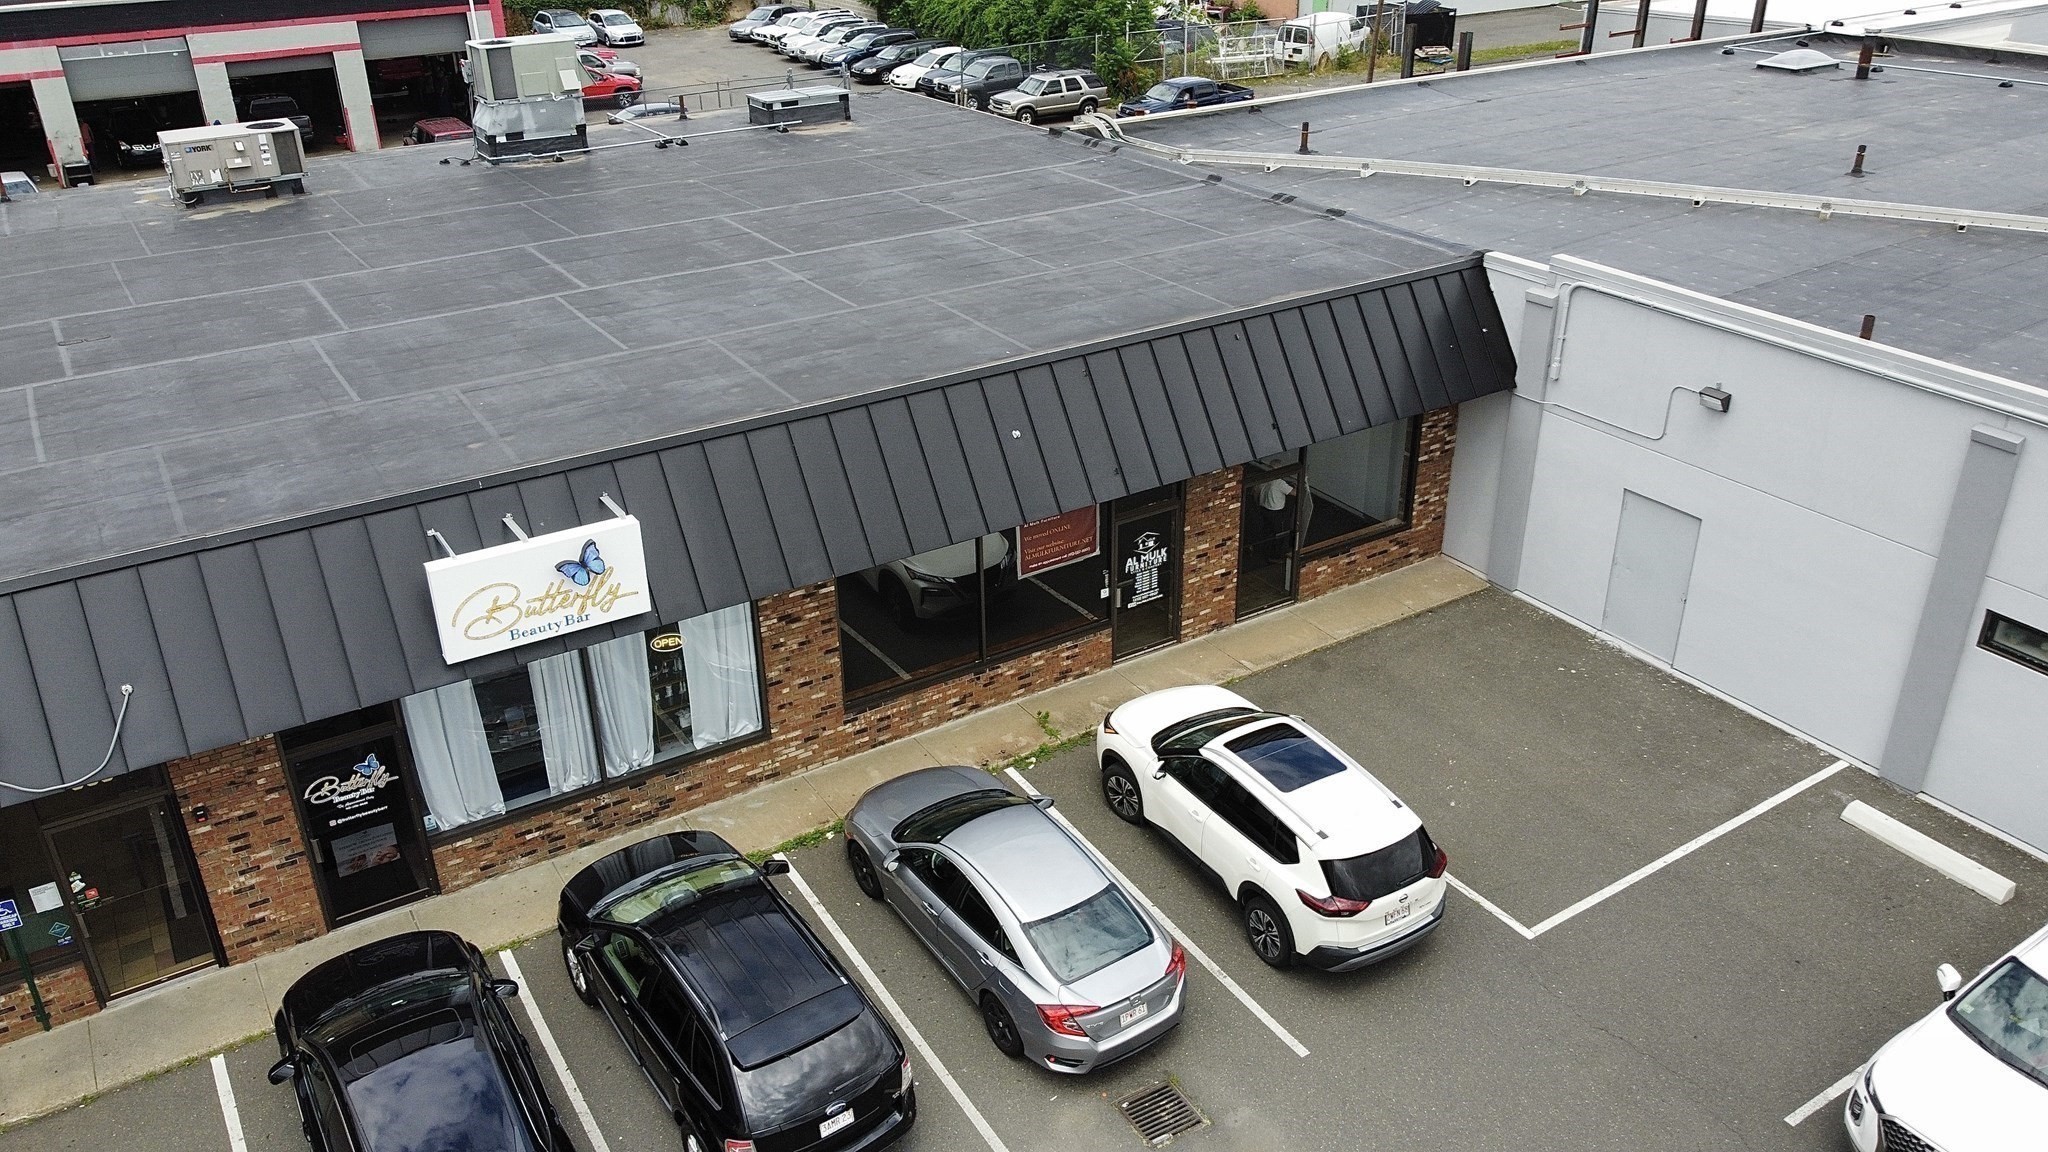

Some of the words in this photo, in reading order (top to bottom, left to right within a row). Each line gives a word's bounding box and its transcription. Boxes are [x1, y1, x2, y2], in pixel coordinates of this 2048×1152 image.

[191, 144, 212, 153] YORK
[1049, 524, 1071, 535] ONLINE
[1125, 556, 1167, 573] FURNITURE
[1126, 556, 1139, 567] AL
[1140, 547, 1168, 562] MULK
[452, 566, 639, 640] Butterfly
[509, 619, 563, 641] Beauty
[564, 613, 591, 627] Bar
[654, 637, 683, 648] OPEN
[303, 765, 399, 804] Butterfly
